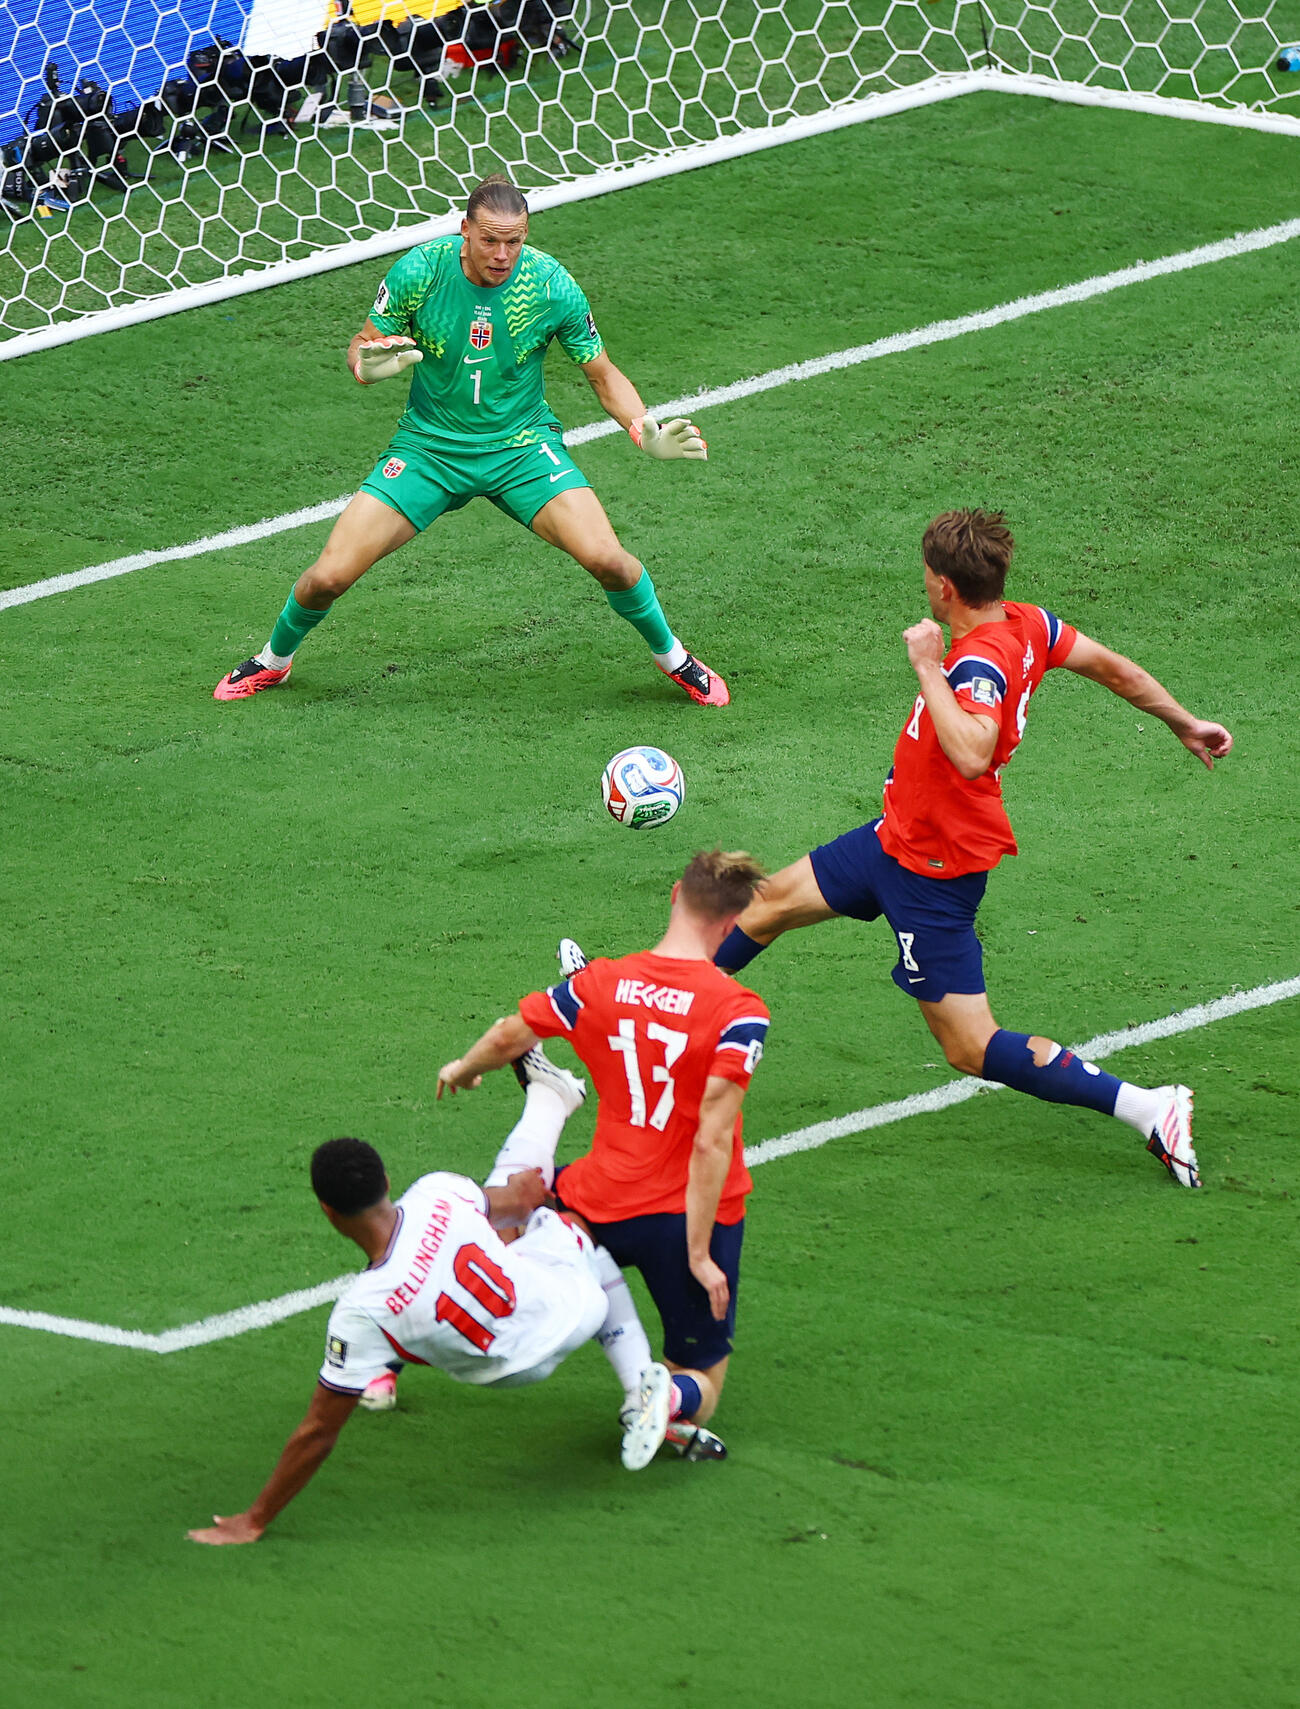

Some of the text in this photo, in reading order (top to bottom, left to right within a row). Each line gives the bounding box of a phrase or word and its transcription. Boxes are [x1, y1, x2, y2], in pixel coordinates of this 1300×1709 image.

[470, 370, 482, 405] 1
[538, 442, 561, 466] 1
[906, 693, 926, 740] 8
[898, 931, 920, 972] 8
[607, 1018, 689, 1132] 13
[385, 1199, 453, 1316] BELLINGHAM
[435, 1242, 517, 1355] 10
